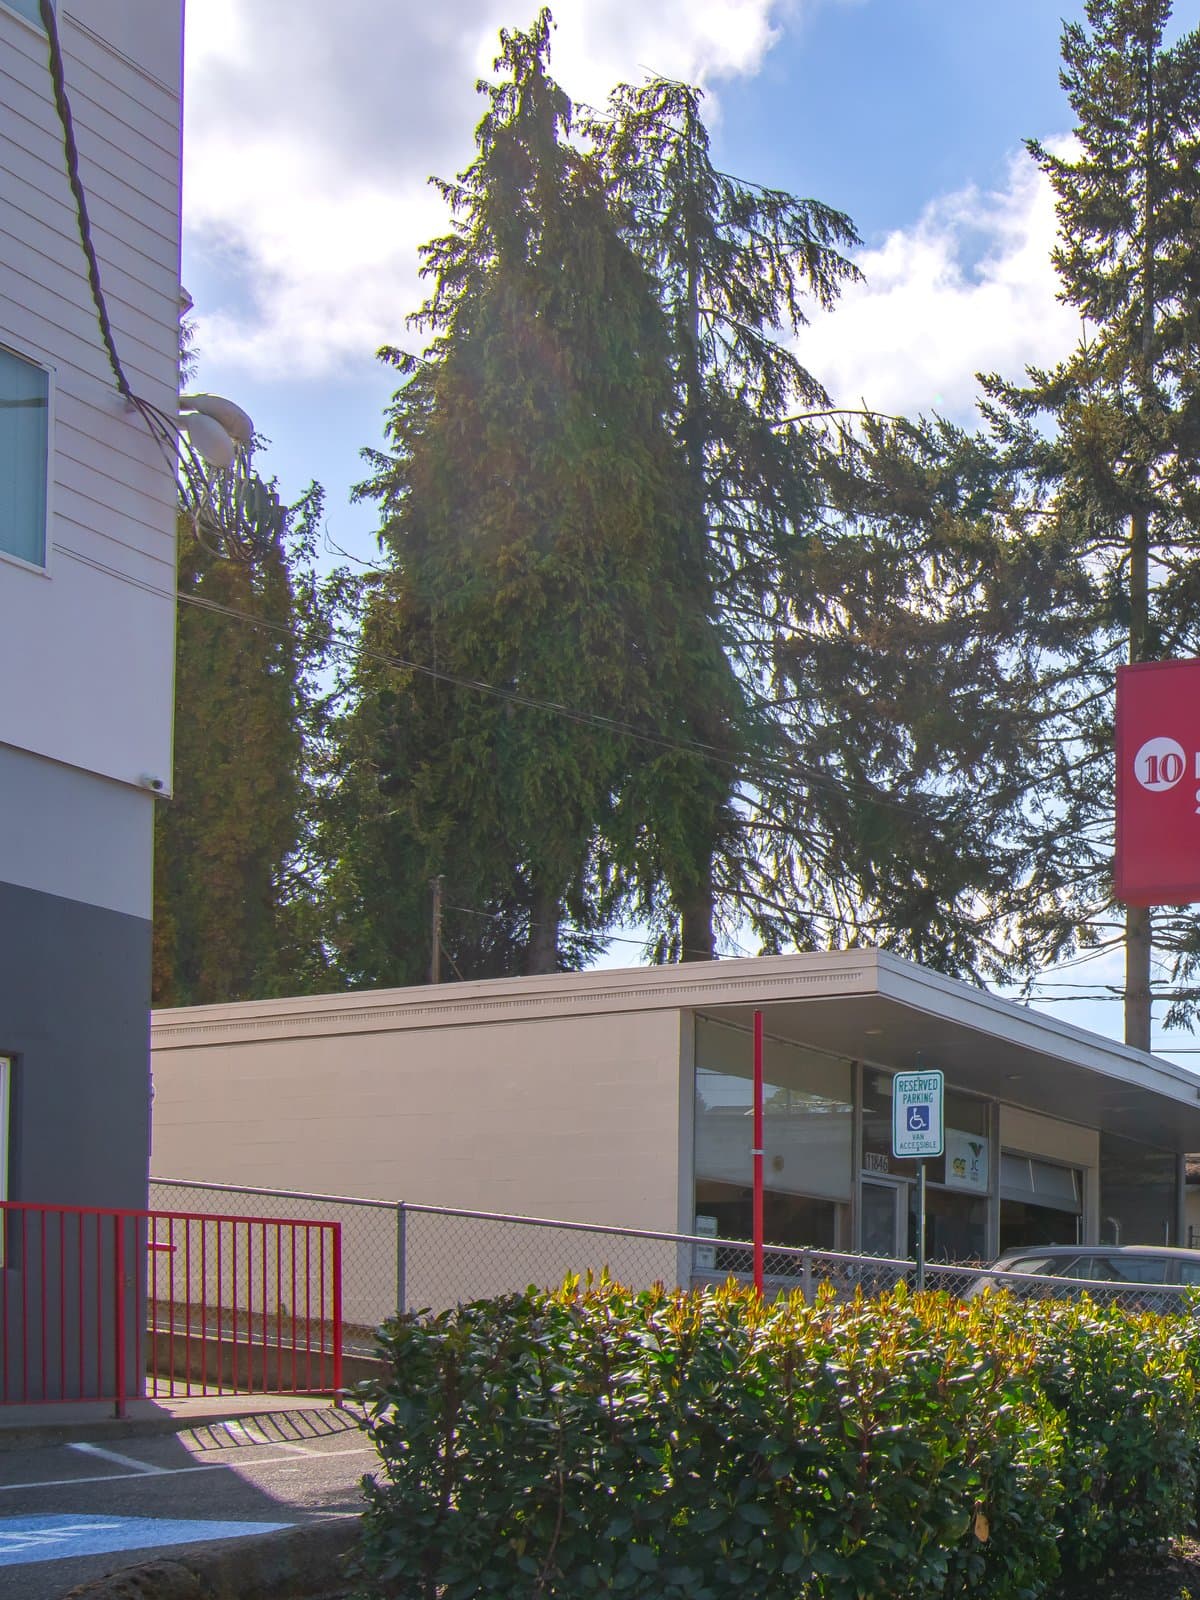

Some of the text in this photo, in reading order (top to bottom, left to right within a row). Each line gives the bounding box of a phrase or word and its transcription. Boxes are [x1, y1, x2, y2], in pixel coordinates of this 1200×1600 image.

[899, 1078, 938, 1092] RESERVED
[903, 1092, 933, 1104] PARKING
[900, 1141, 936, 1149] ACCESSIBLE
